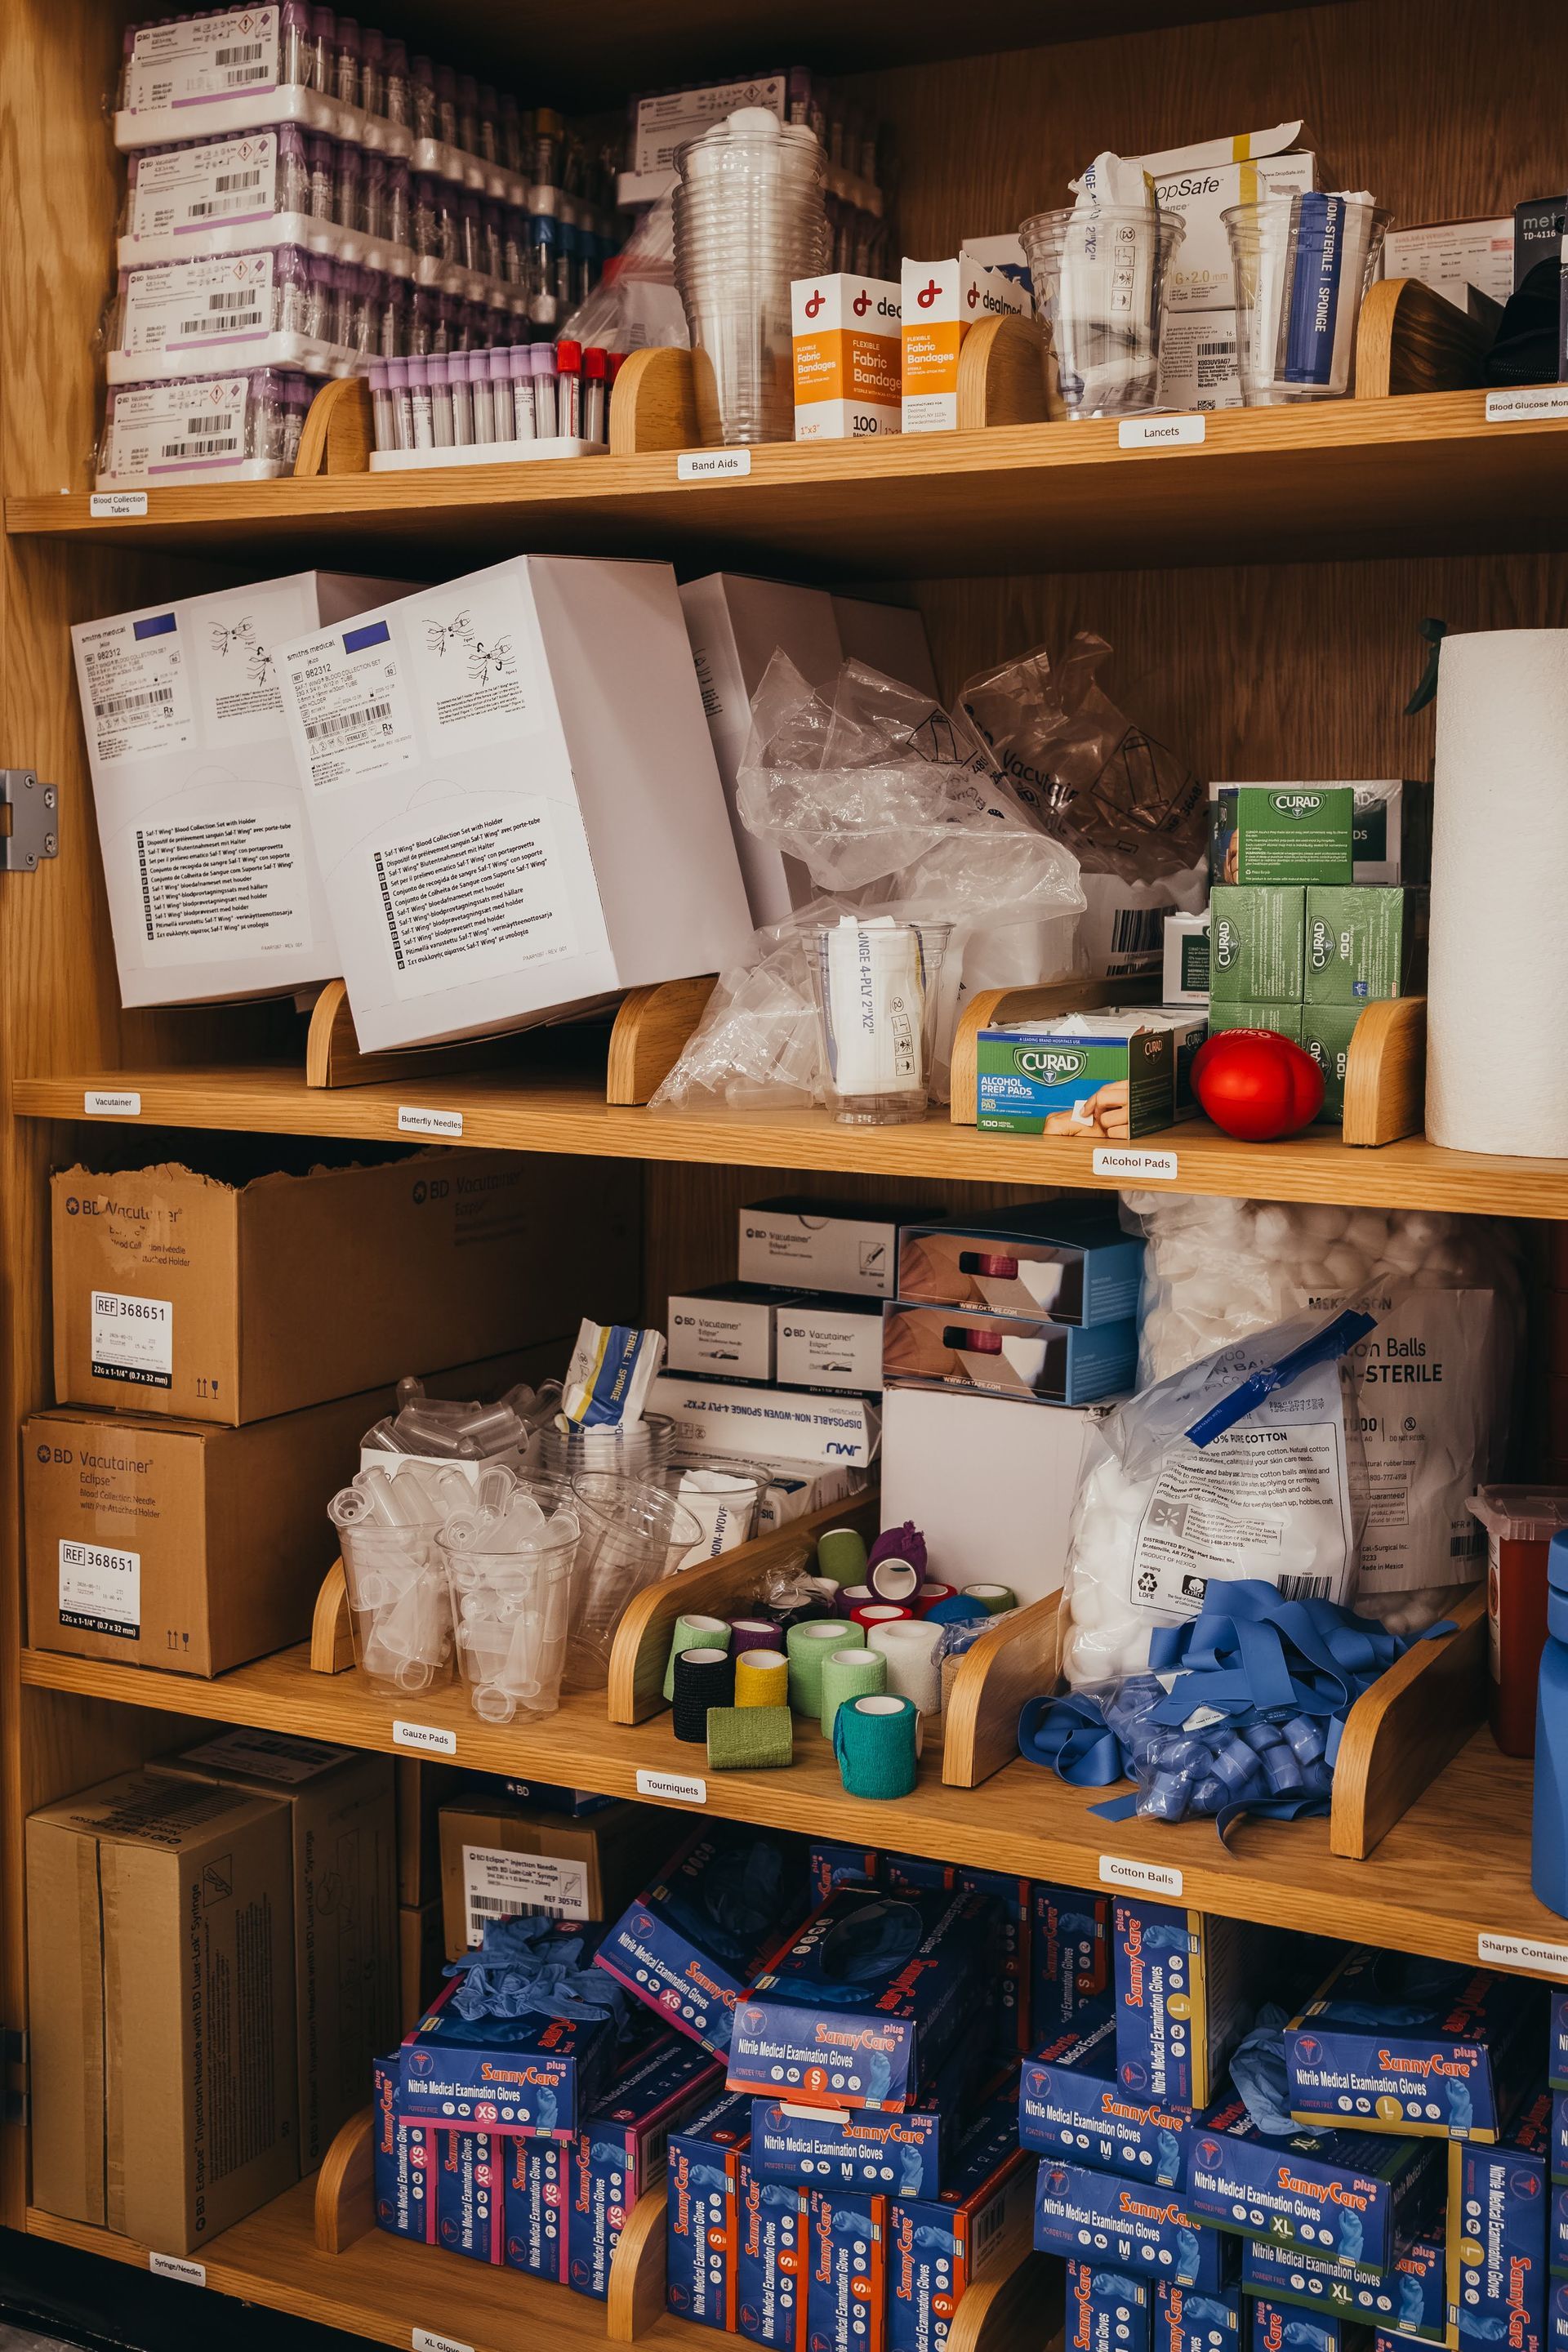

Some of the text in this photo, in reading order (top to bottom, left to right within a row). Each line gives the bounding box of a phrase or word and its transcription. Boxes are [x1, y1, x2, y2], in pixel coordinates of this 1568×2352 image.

[1523, 230, 1556, 240] TD-4116
[1315, 287, 1330, 332] SPONGE
[853, 340, 880, 350] FLEXIBLE
[907, 343, 935, 353] Fabric
[853, 351, 888, 369] Fabric
[907, 354, 954, 363] Bandages
[853, 369, 902, 389] Bandage
[1490, 403, 1512, 411] Blood
[1515, 401, 1548, 409] Glucose
[853, 416, 877, 433] 100
[1144, 426, 1179, 438] Lancets
[692, 459, 737, 470] Band Aids
[287, 640, 335, 661] smiths medical
[305, 663, 332, 678] 982312
[1276, 796, 1320, 808] CURAD
[385, 849, 399, 858] Saf-T
[416, 840, 432, 848] Blood
[433, 831, 461, 843] Collection
[471, 823, 483, 832] with
[484, 818, 503, 828] Holder
[1217, 921, 1230, 967] CURAD
[1312, 922, 1325, 967] CURAD
[1339, 932, 1349, 960] 100
[858, 932, 875, 1034] ONGE 4-PLY 2"X2"
[1144, 1040, 1163, 1055] CURAD
[1022, 1053, 1079, 1071] CURAD
[981, 1076, 1022, 1087] ALCOHOL
[982, 1085, 1005, 1093] PREP
[1008, 1086, 1032, 1096] PADS
[96, 1098, 131, 1107] Vacutainer
[401, 1114, 462, 1129] Butterfly Needles
[1102, 1156, 1170, 1169] Alcohol Pads
[98, 1298, 164, 1321] REF 368651
[794, 1329, 805, 1337] BD
[1388, 1338, 1426, 1357] Balls
[684, 1399, 862, 1429] DISPOSABLE NON-WOVEN SPONGE 4-PLY 2"X2"
[1232, 1432, 1287, 1444] PURE COTTON
[54, 1449, 73, 1463] BD
[1252, 1450, 1266, 1458] pure
[1267, 1447, 1289, 1456] cotton.
[80, 1489, 98, 1498] Blood
[133, 1495, 155, 1506] Needle
[81, 1501, 95, 1509] with
[139, 1508, 160, 1519] Holder
[1143, 1537, 1177, 1548] DISTRIBUTED
[66, 1548, 132, 1573] REF 368651
[62, 1615, 72, 1623] 22G
[97, 1620, 108, 1629] (0.7
[114, 1625, 121, 1633] 32
[122, 1627, 136, 1637] mm)
[403, 1728, 448, 1745] Gauze Pads
[516, 1785, 529, 1796] BD
[647, 1780, 698, 1796] Tourniquets
[1110, 1863, 1174, 1885] Cotton Balls
[1481, 1939, 1568, 1962] Sharps Containe
[1125, 1919, 1145, 2007] SunnyCare
[816, 2024, 904, 2051] SunnyCare plus
[738, 2038, 853, 2067] Nitrile Medical Examination Gloves
[1379, 2047, 1477, 2078] SunnyCare plus
[482, 2062, 566, 2086] SunnyCare plus
[812, 2071, 821, 2084] S
[1297, 2069, 1427, 2096] Nitrile Medical Examination Gloves
[408, 2080, 520, 2101] Nitrile Medical Examination Gloves
[478, 2106, 497, 2118] XS
[1102, 2094, 1183, 2132] SunnyCare
[1383, 2101, 1394, 2114] L
[1026, 2100, 1141, 2143] Nitrile Medical Examination Gloves
[842, 2118, 932, 2144] SunnyCare plus
[764, 2136, 883, 2160] Nitrile Medical Examination Gloves
[1101, 2140, 1111, 2155] M
[841, 2163, 853, 2176] M
[1195, 2172, 1321, 2221] Nitrile Medical Examination Gloves
[1277, 2167, 1377, 2211] SunnyCare plus
[1272, 2216, 1293, 2236] XL
[154, 2258, 202, 2278] Syringe/Needles
[425, 2337, 463, 2352] XL Glove
